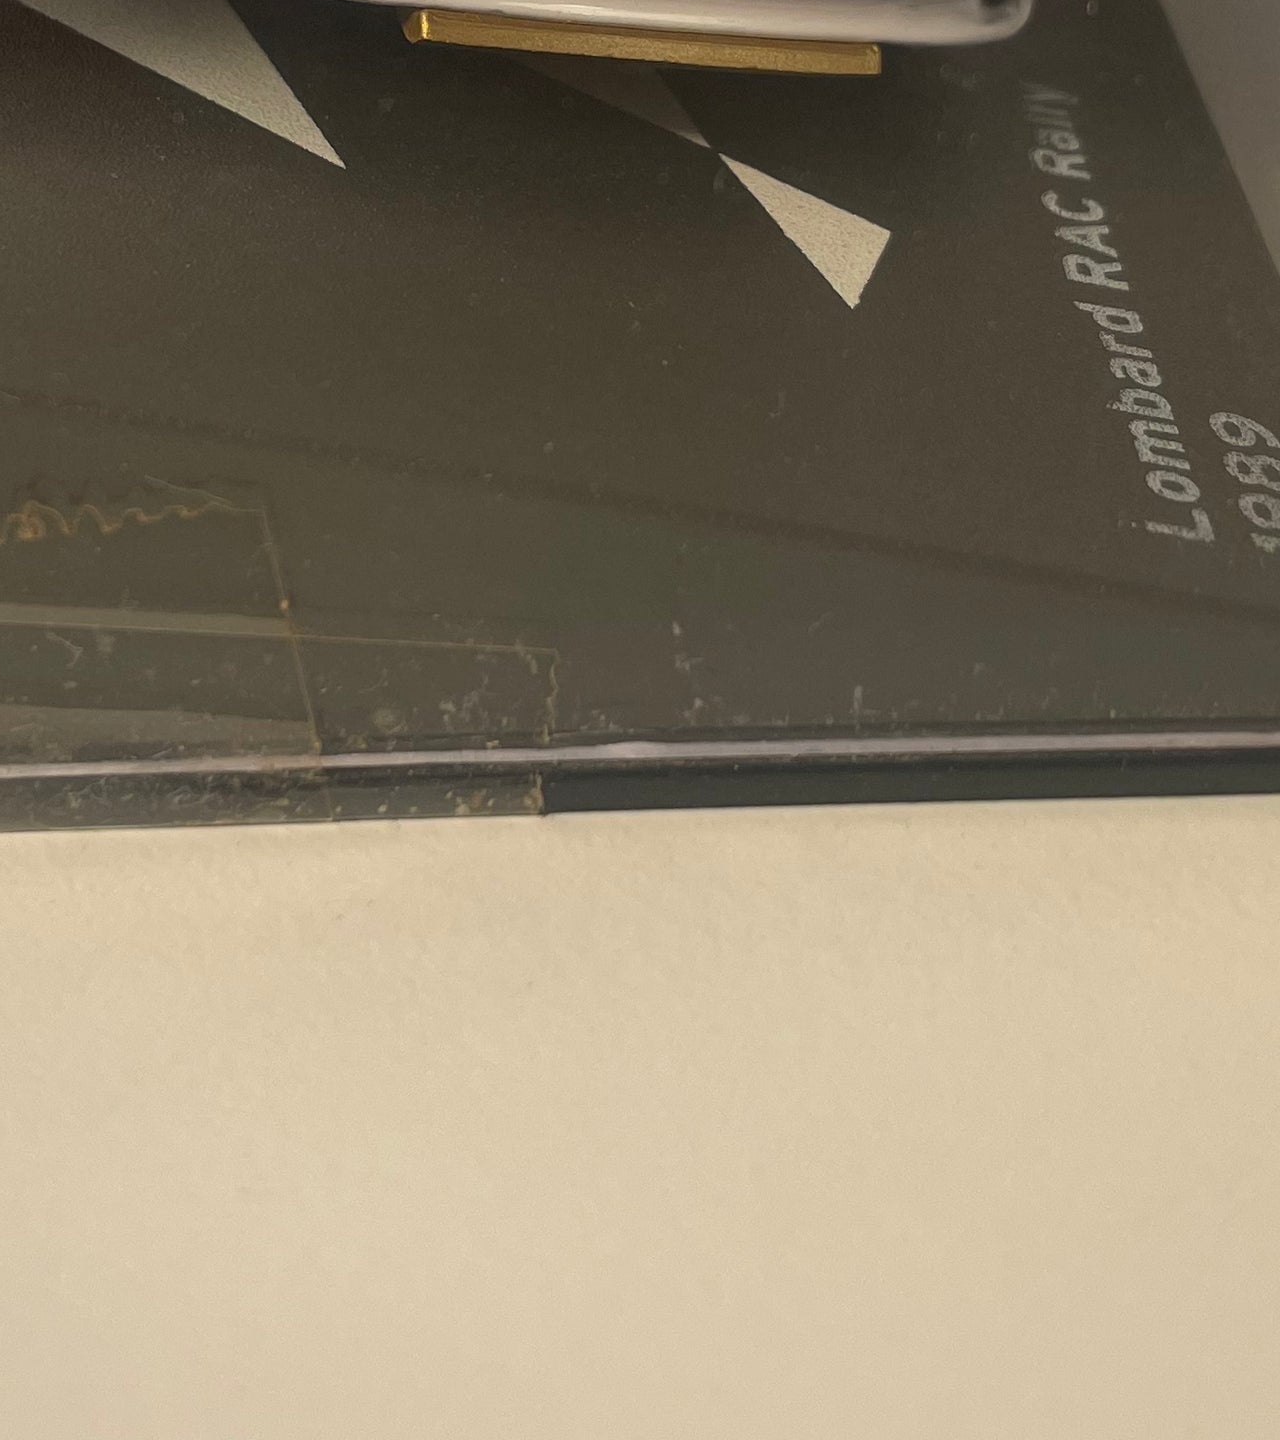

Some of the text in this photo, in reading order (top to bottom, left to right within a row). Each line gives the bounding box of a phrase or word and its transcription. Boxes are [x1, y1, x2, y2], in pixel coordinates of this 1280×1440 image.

[1022, 81, 1215, 543] Lombard RAC Rally
